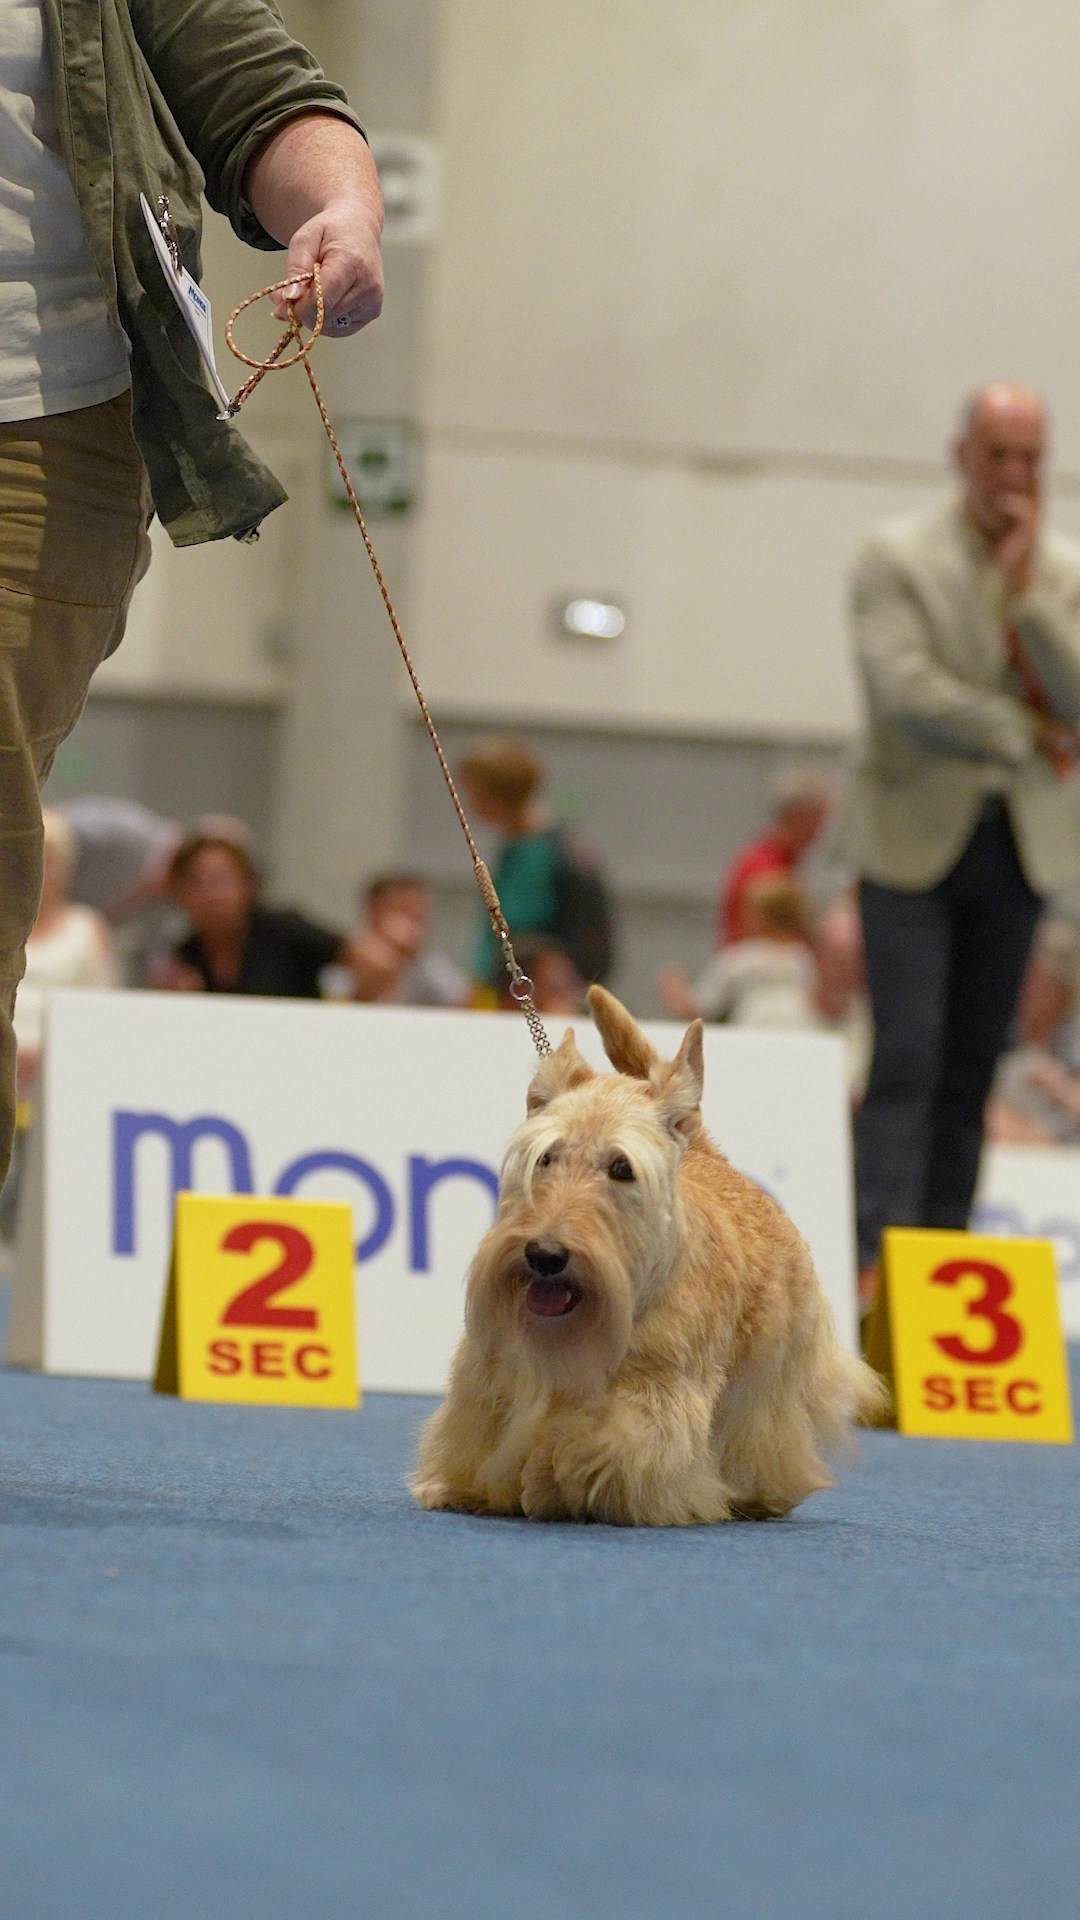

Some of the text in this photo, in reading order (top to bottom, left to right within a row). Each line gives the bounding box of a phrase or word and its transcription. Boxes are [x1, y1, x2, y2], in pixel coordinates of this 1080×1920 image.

[113, 1110, 499, 1272] mon
[219, 1220, 318, 1330] 2
[928, 1257, 1025, 1368] 3
[207, 1339, 332, 1380] SEC
[922, 1375, 1042, 1416] SEC
